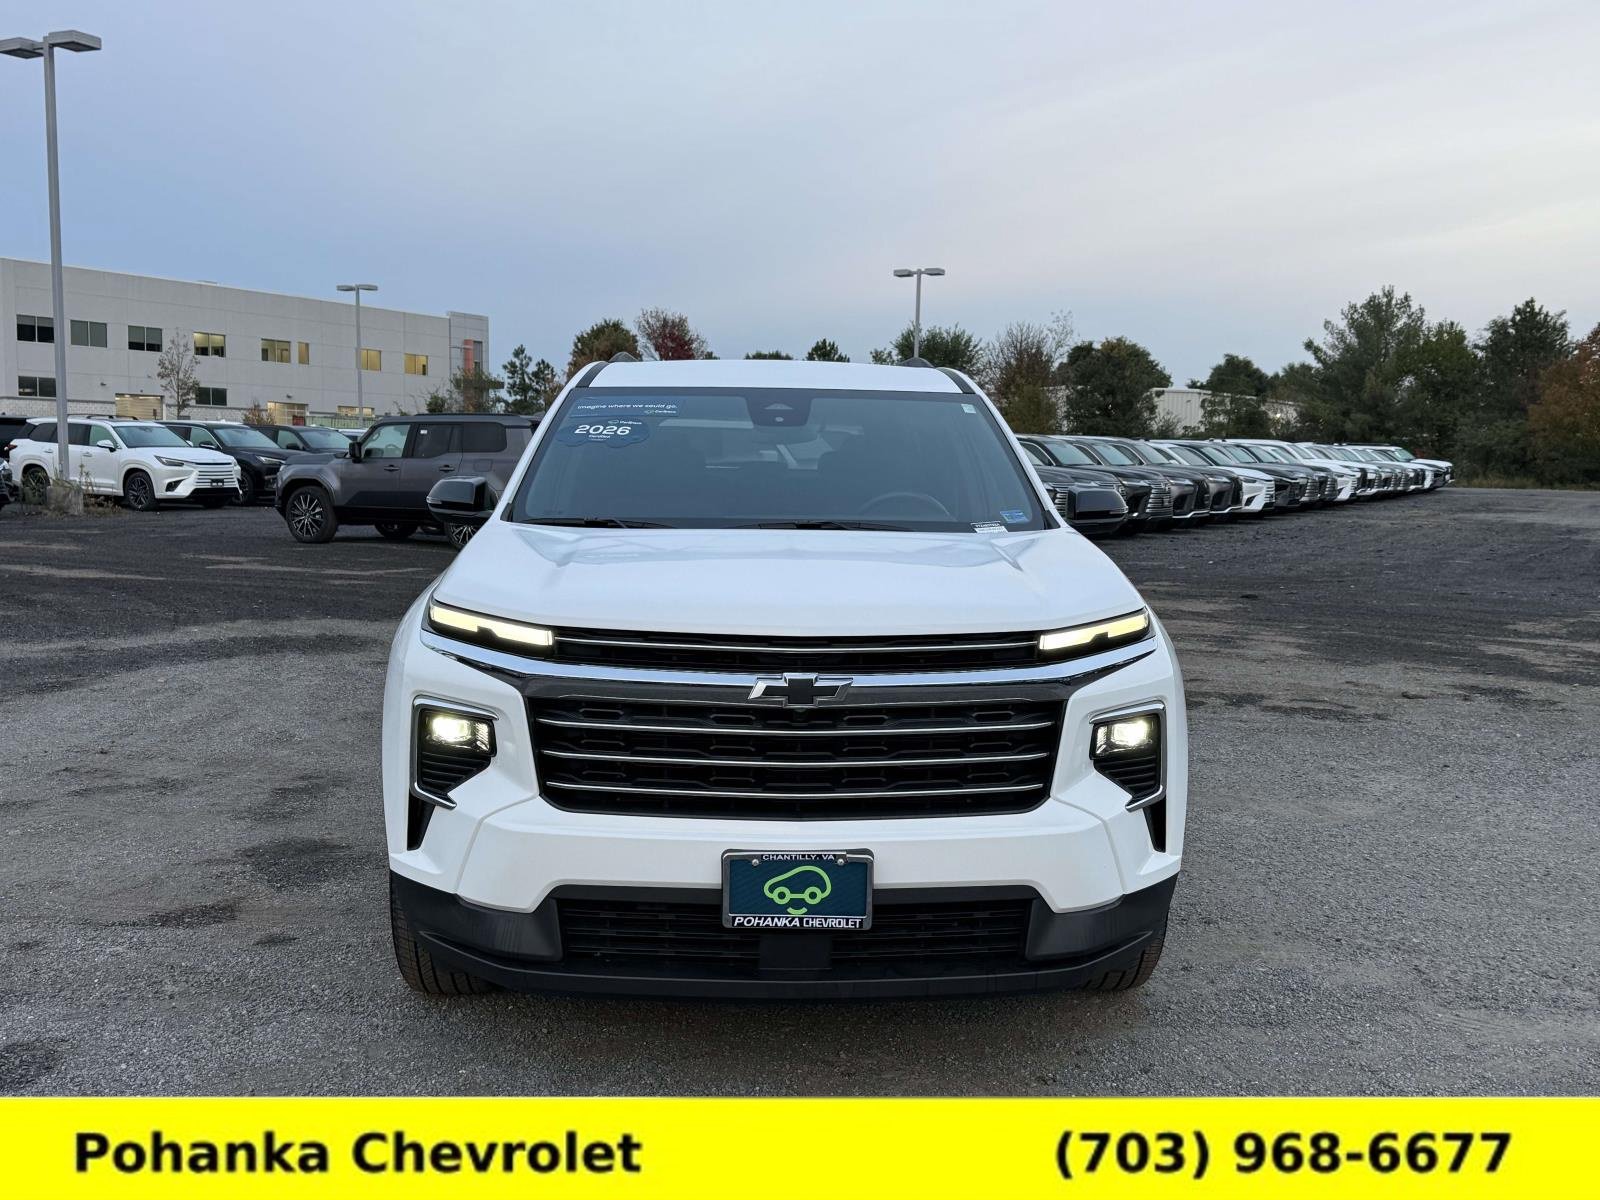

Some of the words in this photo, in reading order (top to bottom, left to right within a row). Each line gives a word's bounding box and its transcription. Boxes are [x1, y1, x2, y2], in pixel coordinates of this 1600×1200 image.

[574, 425, 632, 435] 2026
[733, 916, 801, 928] POHANKA
[803, 917, 862, 929] CHEVROLET
